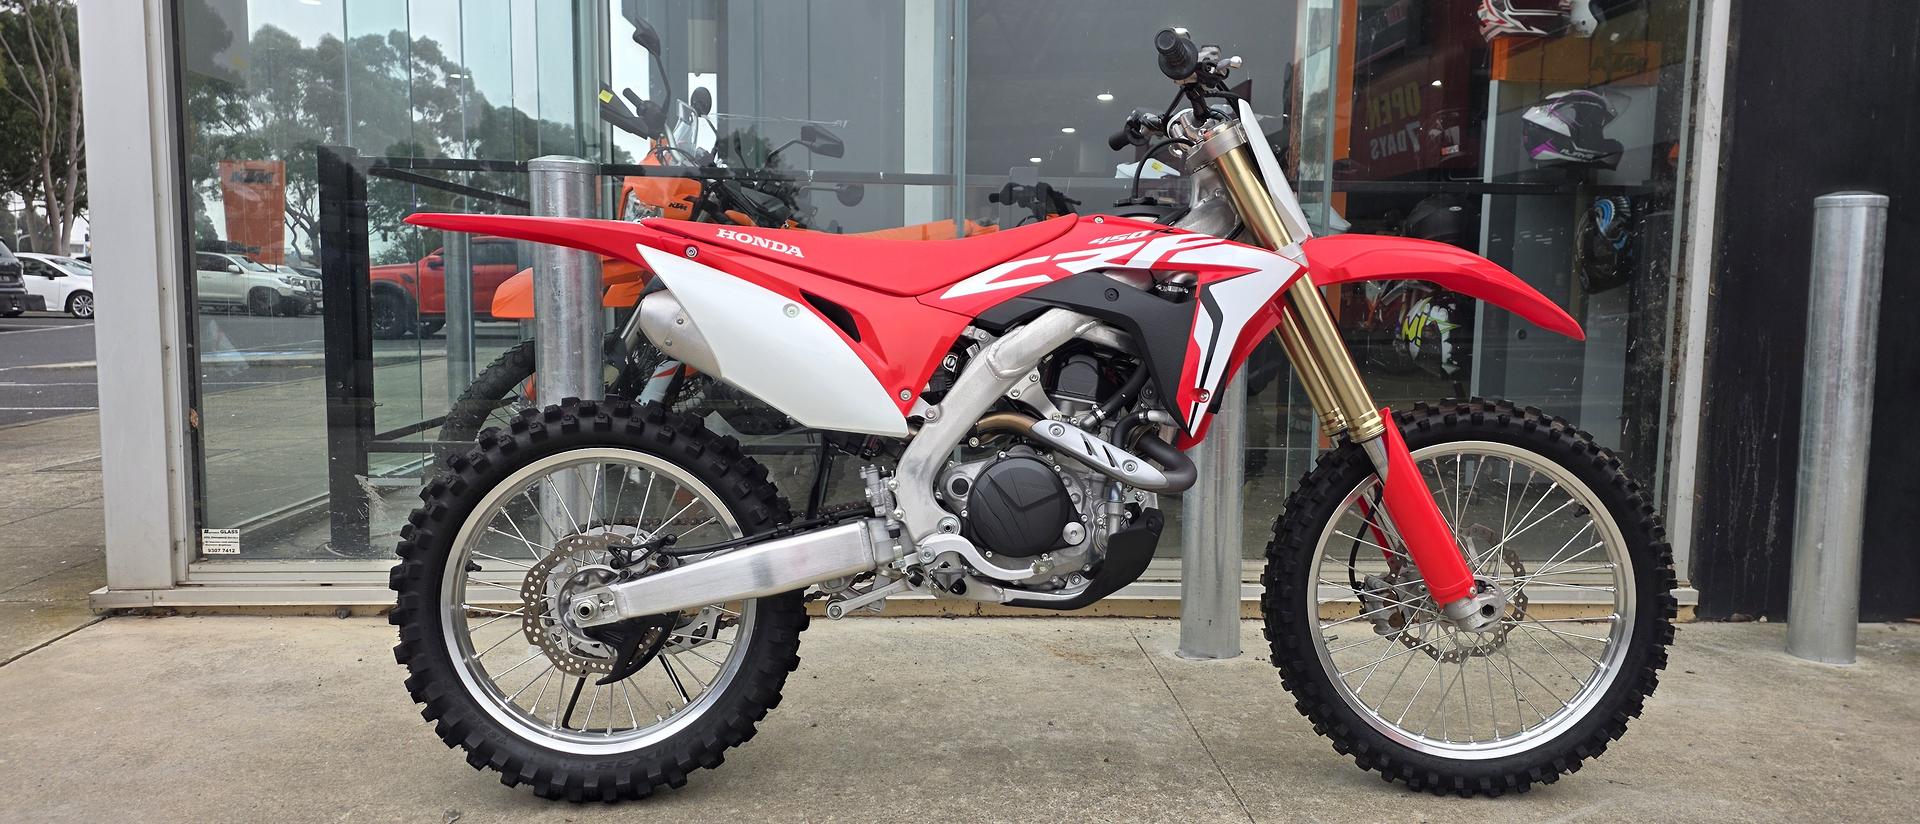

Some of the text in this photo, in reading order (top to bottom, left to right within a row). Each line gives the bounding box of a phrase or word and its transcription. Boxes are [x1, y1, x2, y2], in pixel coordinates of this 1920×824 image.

[668, 202, 688, 212] KTM
[716, 228, 805, 258] HONDA
[1088, 230, 1153, 244] 450
[939, 233, 1226, 299] CRF
